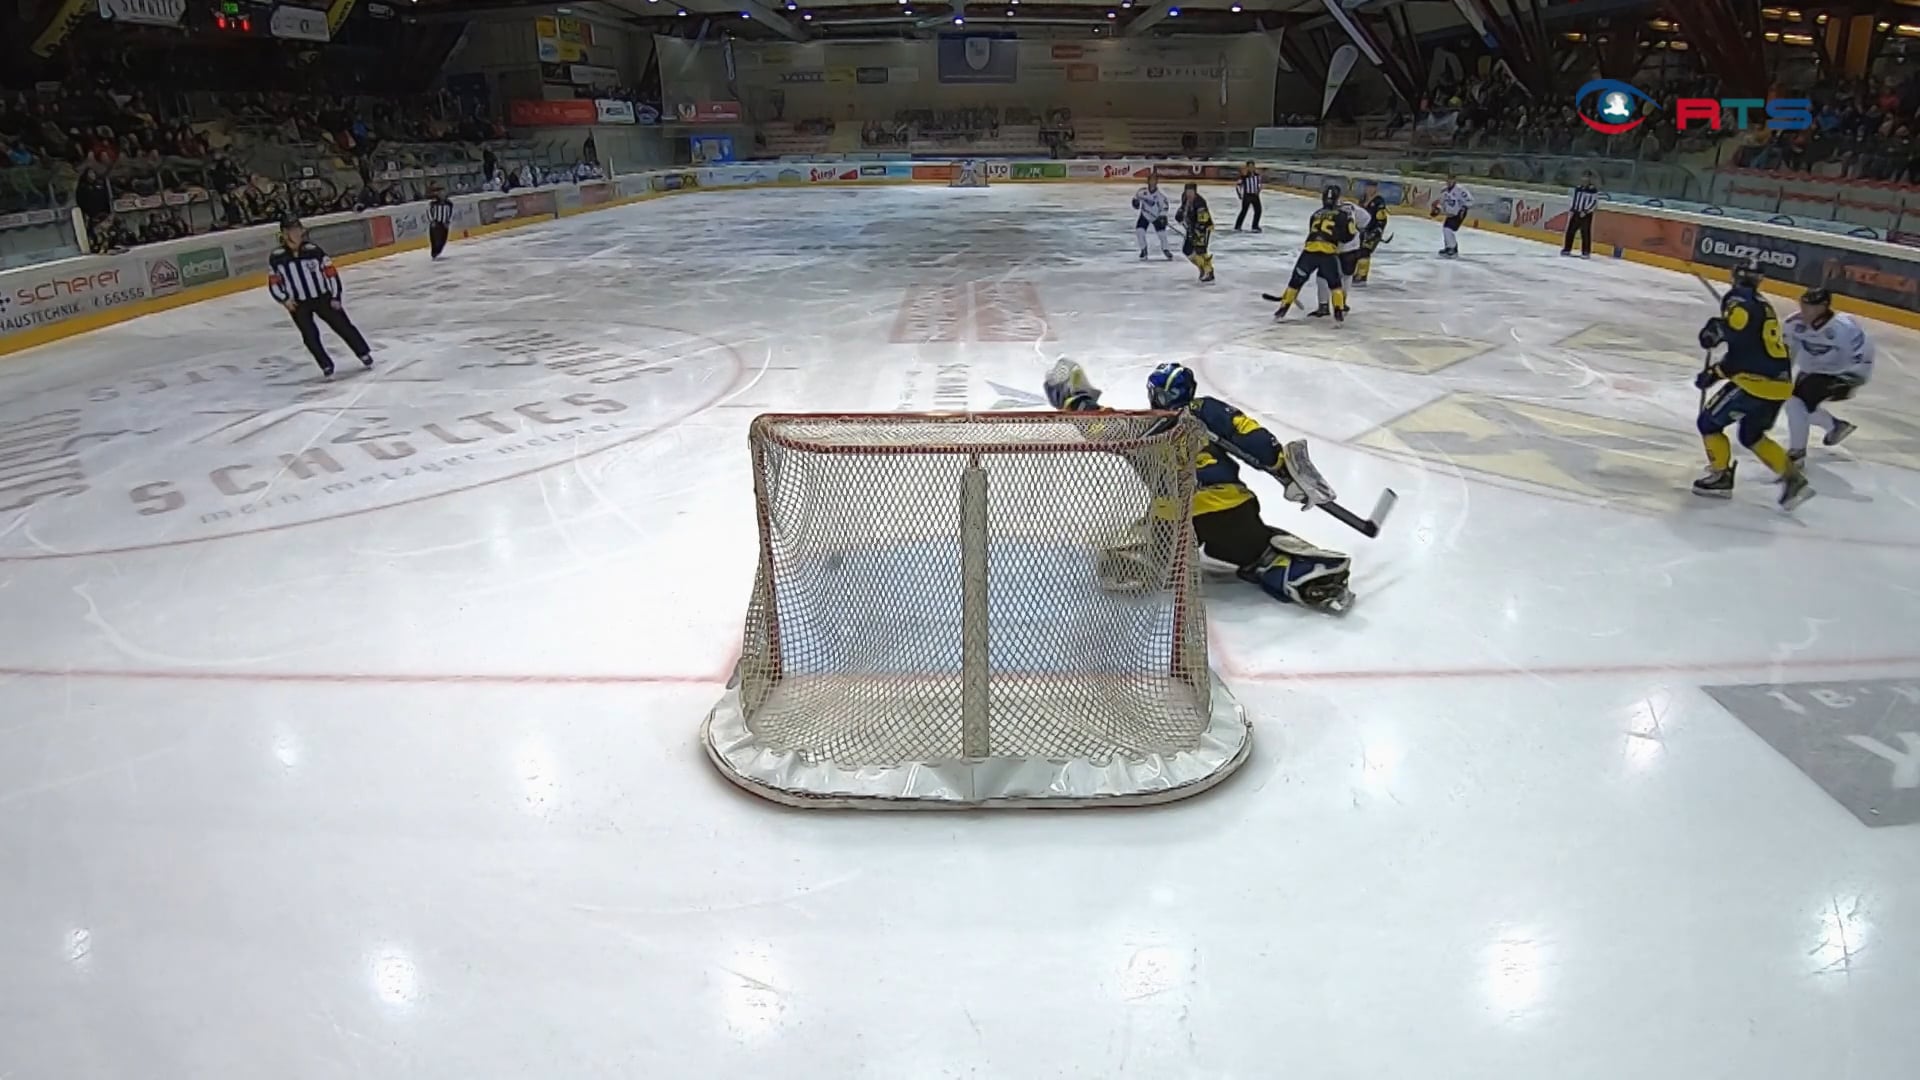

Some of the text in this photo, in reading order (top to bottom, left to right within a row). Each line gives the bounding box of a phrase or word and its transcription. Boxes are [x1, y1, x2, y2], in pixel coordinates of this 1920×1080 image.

[1714, 241, 1797, 269] BLIZZARD
[17, 269, 120, 306] scherer
[0, 303, 81, 332] HAUSTECHNIK
[130, 393, 629, 516] SCHULTES
[201, 494, 300, 524] mein
